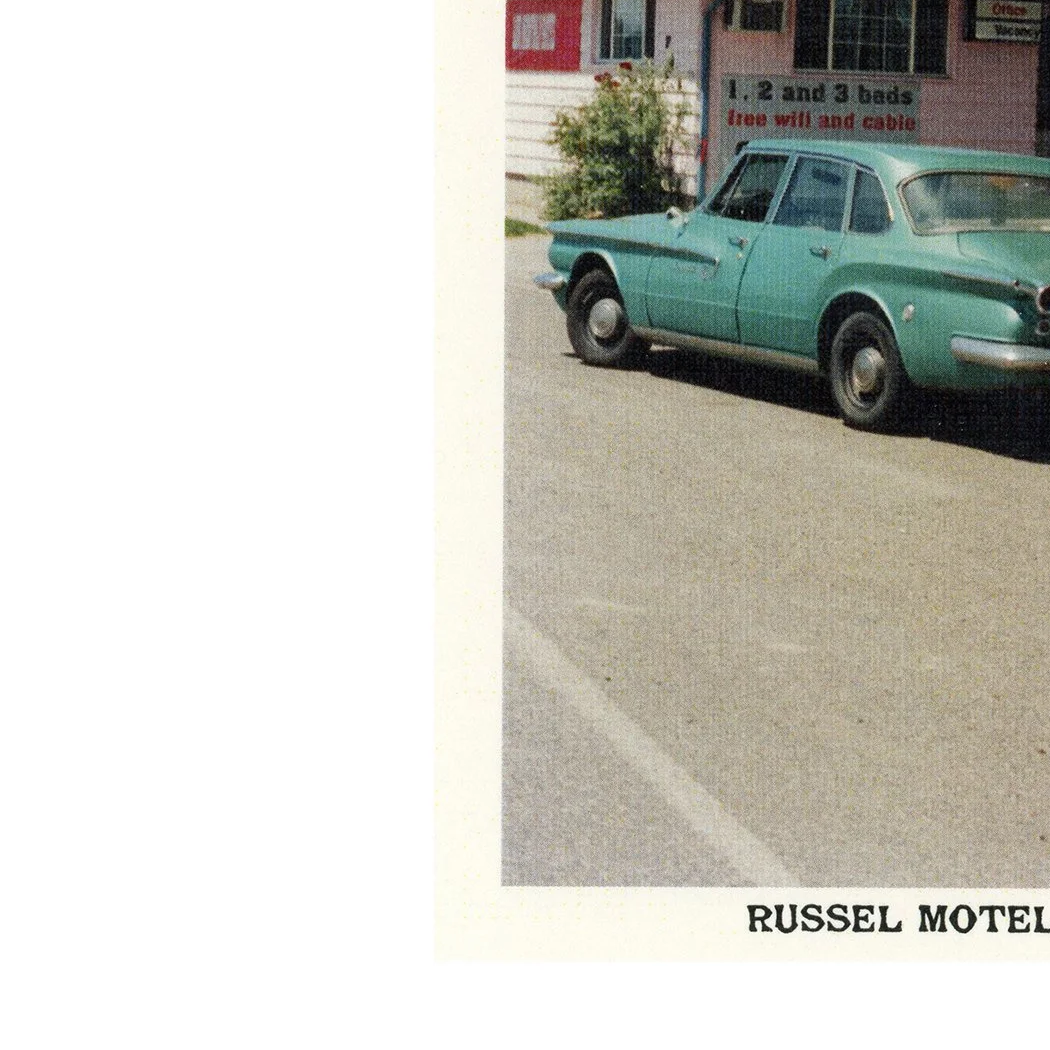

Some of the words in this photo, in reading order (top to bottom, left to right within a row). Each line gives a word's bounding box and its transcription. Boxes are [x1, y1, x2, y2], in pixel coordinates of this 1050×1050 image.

[758, 80, 773, 100] 2
[782, 83, 826, 102] and
[834, 83, 848, 103] 3
[858, 84, 913, 105] beds
[818, 112, 855, 131] and
[862, 113, 916, 132] cable
